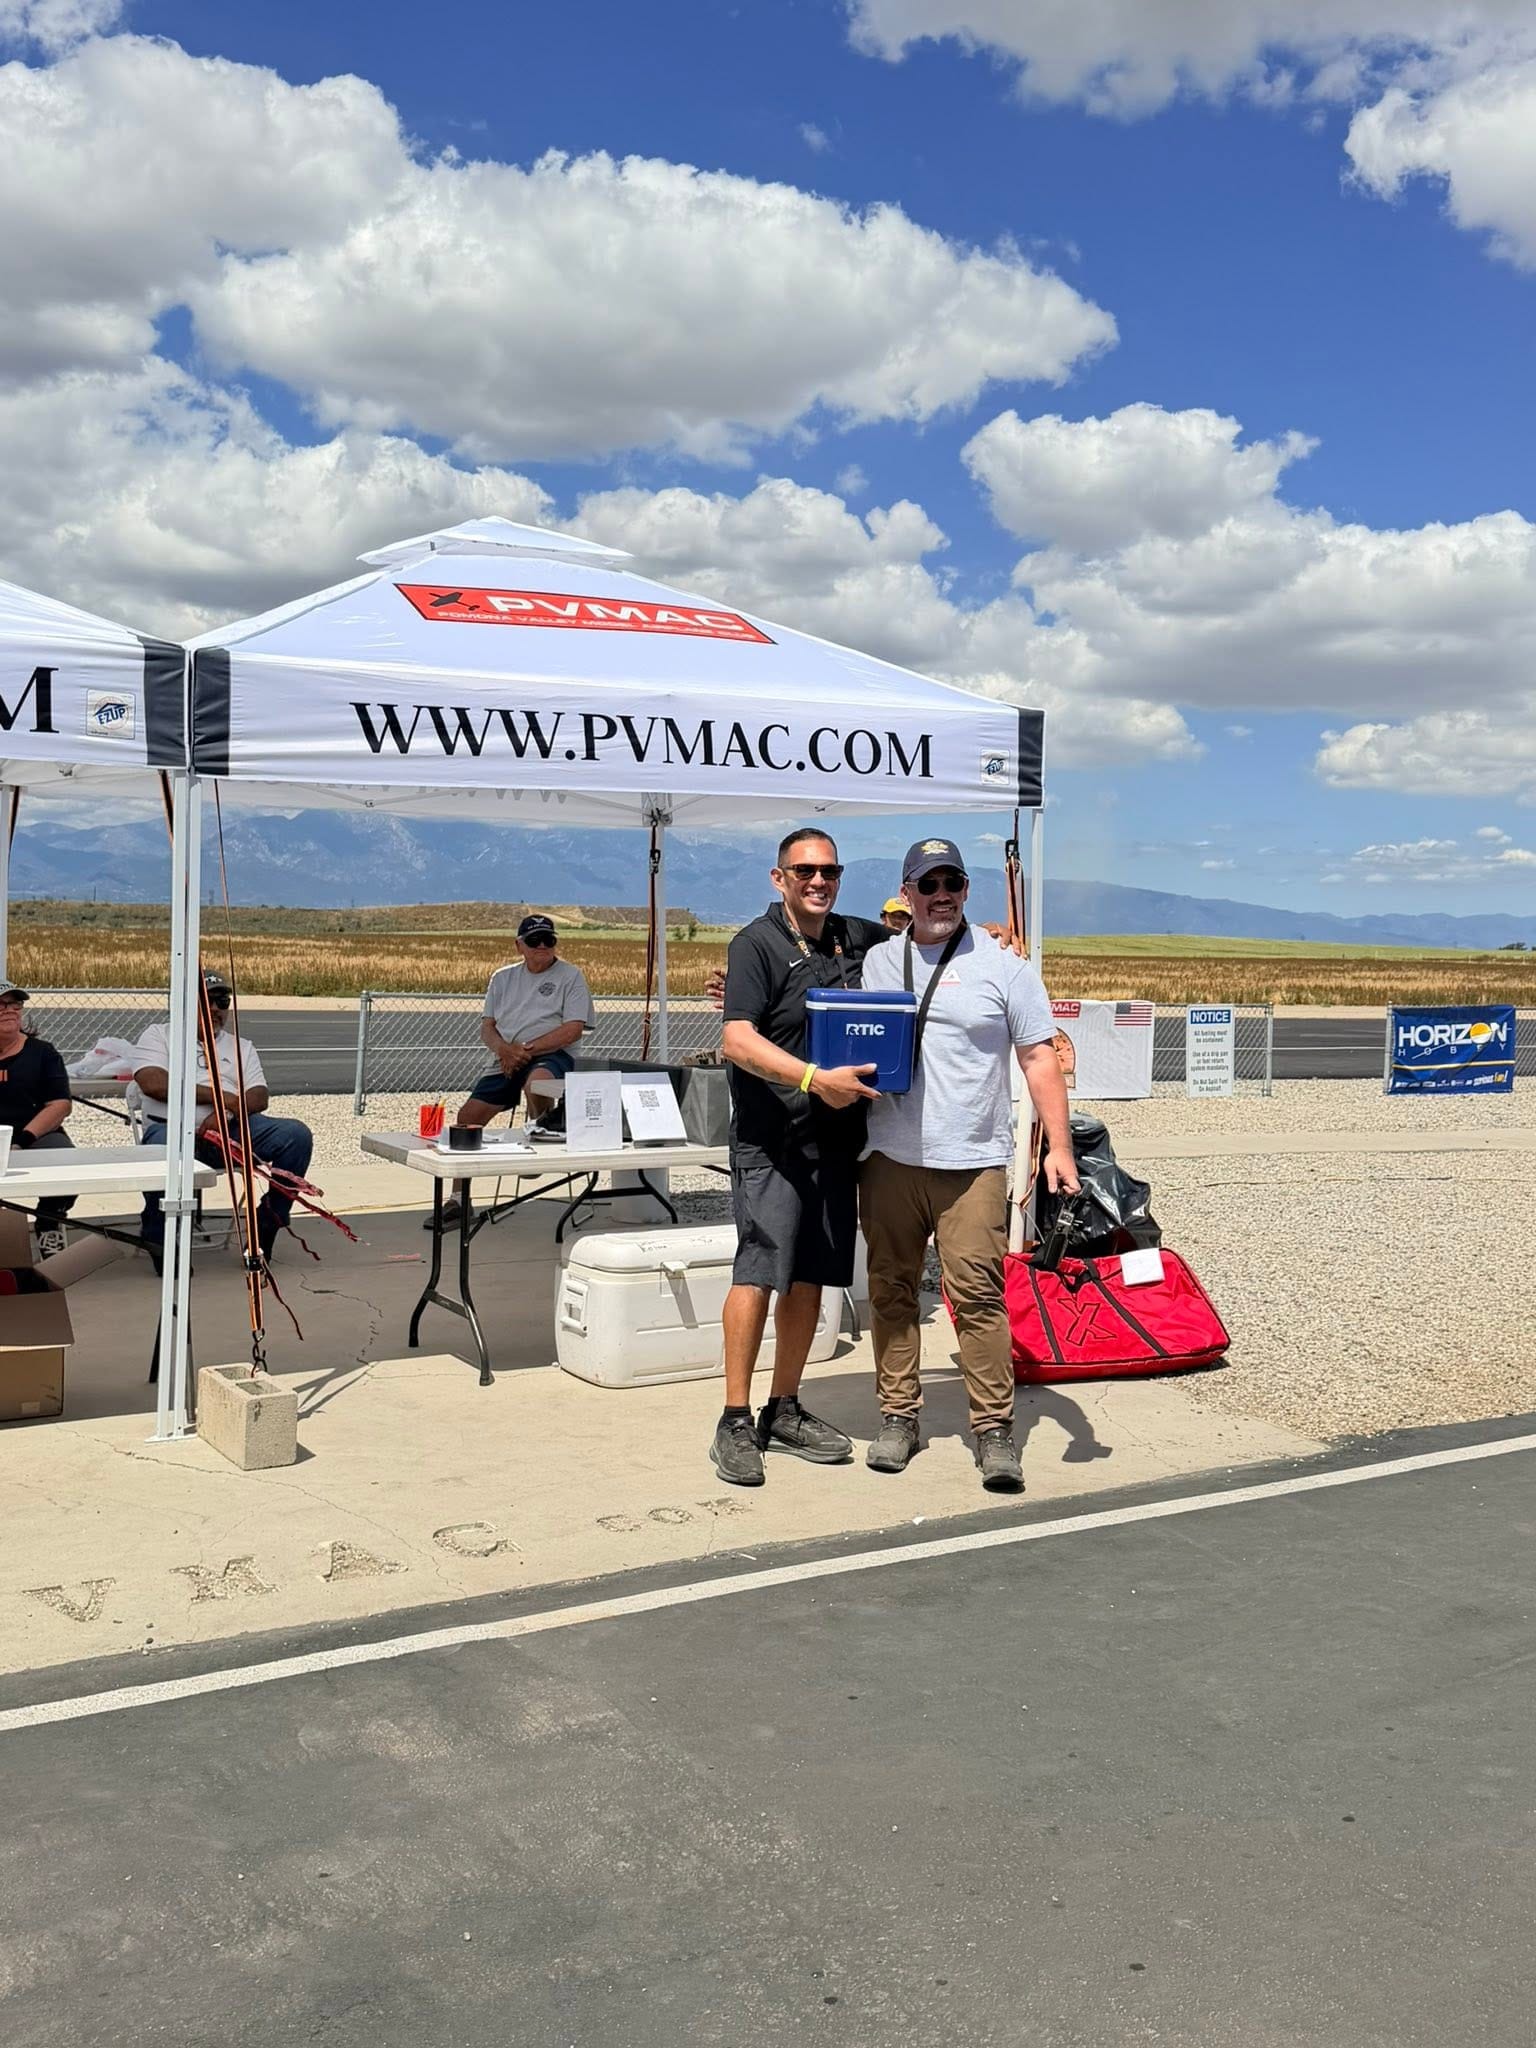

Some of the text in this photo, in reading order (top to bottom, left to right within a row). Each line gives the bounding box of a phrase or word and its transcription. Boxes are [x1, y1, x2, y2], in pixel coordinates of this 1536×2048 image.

[486, 595, 744, 631] PVMAC
[349, 702, 934, 778] WWW.PVMAC.COM
[1052, 1003, 1079, 1012] MAC
[1192, 1011, 1230, 1023] NOTICE
[846, 1023, 885, 1036] RTIC
[1398, 1022, 1507, 1048] HORIZON
